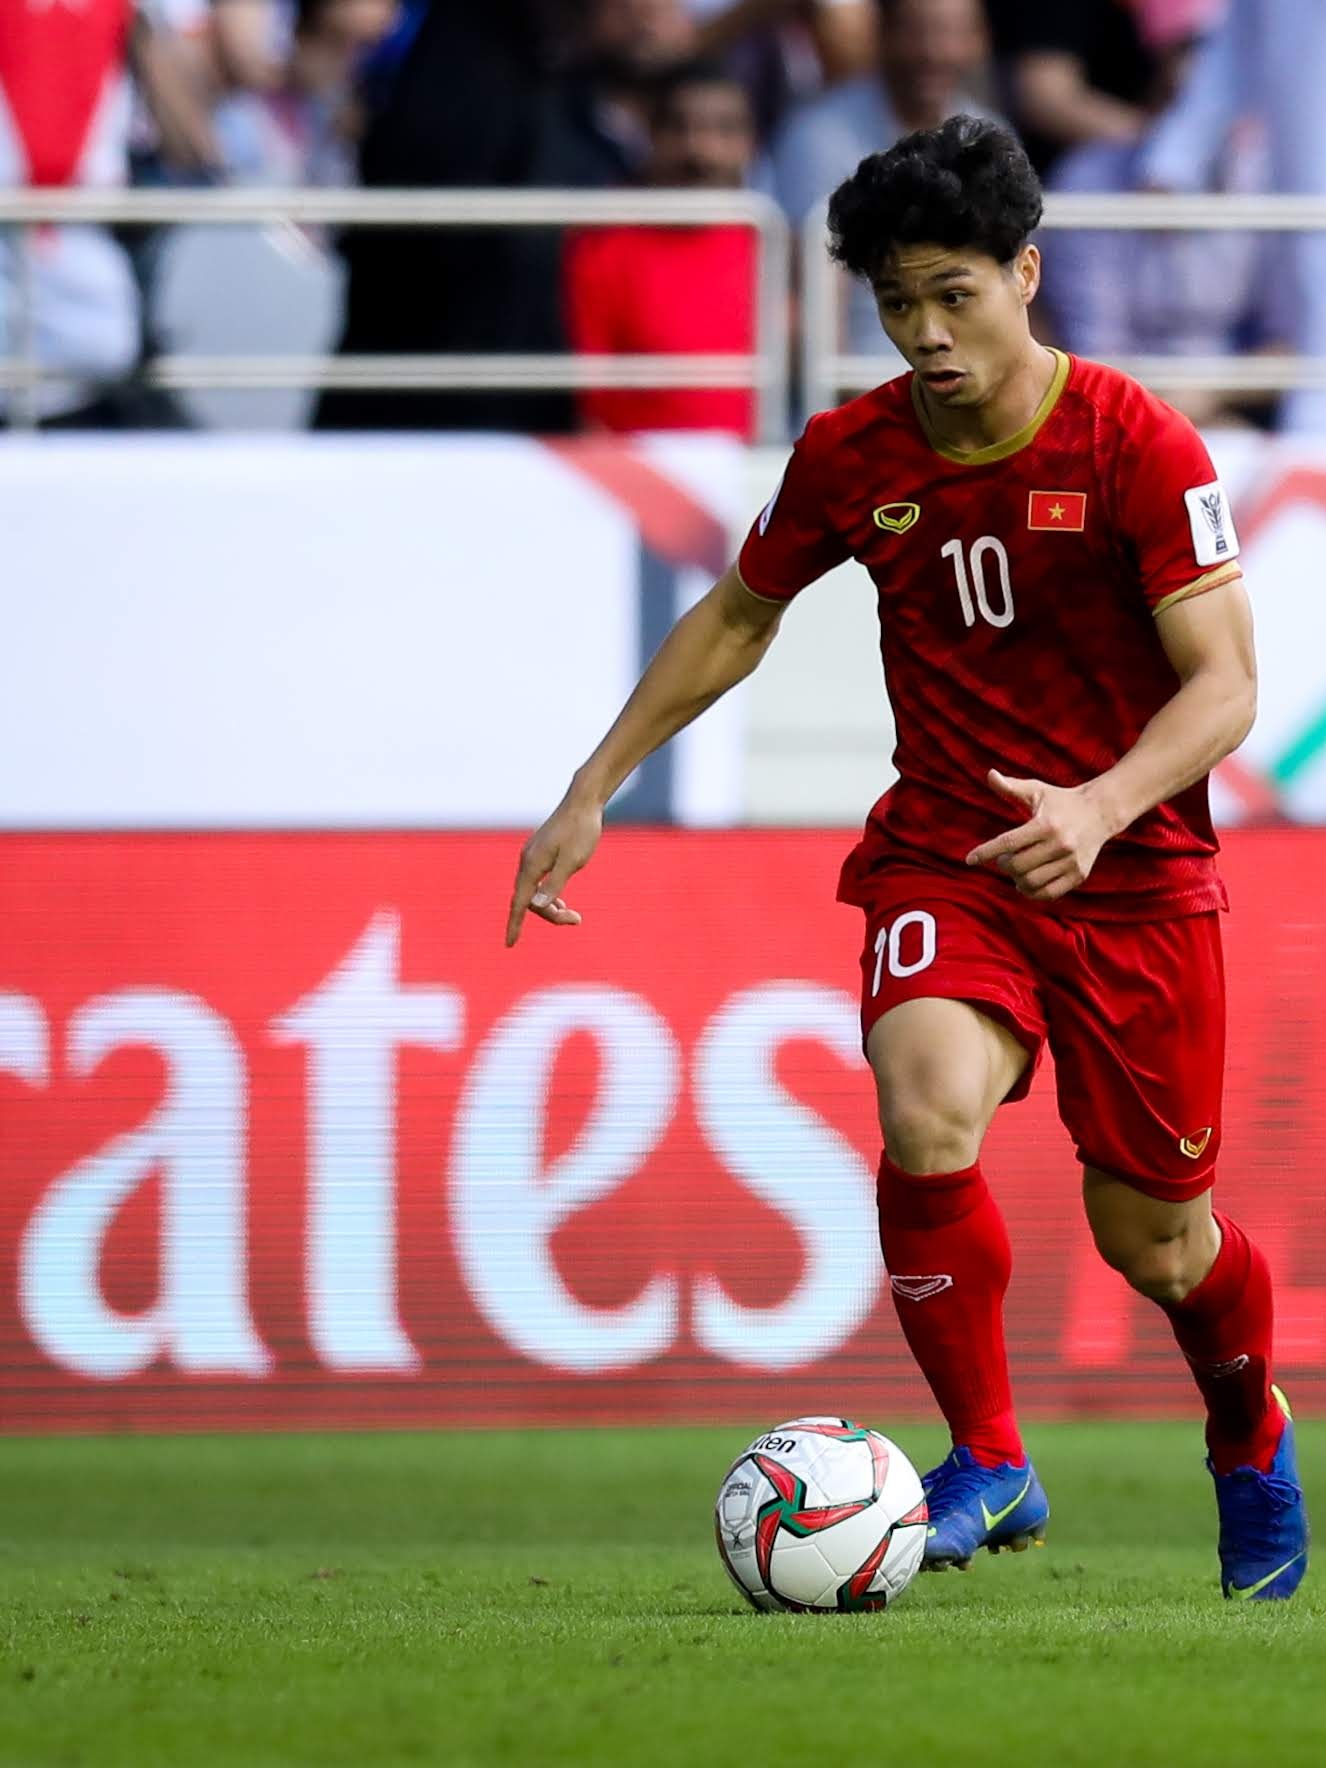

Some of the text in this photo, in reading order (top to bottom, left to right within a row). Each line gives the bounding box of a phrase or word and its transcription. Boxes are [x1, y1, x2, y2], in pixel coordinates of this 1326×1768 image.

[941, 535, 1015, 628] 10
[871, 909, 936, 998] 10
[0, 908, 886, 1376] ates
